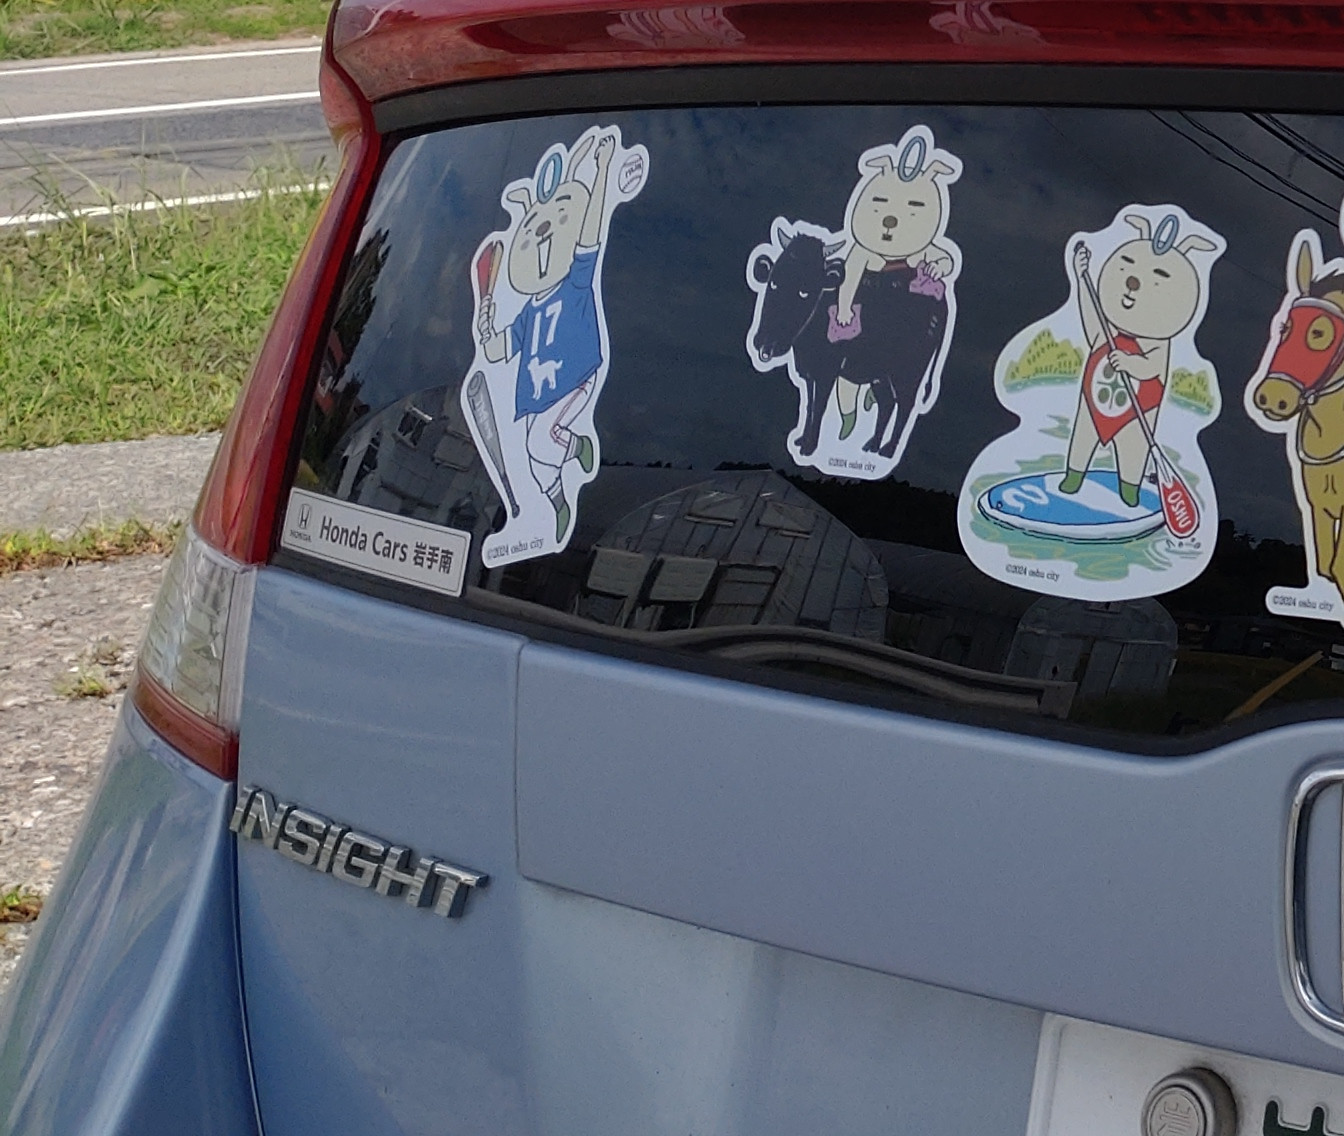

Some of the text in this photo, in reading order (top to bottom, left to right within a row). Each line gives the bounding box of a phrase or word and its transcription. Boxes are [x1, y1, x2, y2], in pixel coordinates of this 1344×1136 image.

[530, 305, 564, 357] 17
[1168, 491, 1192, 528] OSHU
[319, 515, 368, 552] Honda
[372, 531, 409, 563] Cars
[230, 783, 490, 919] INSIGHT
